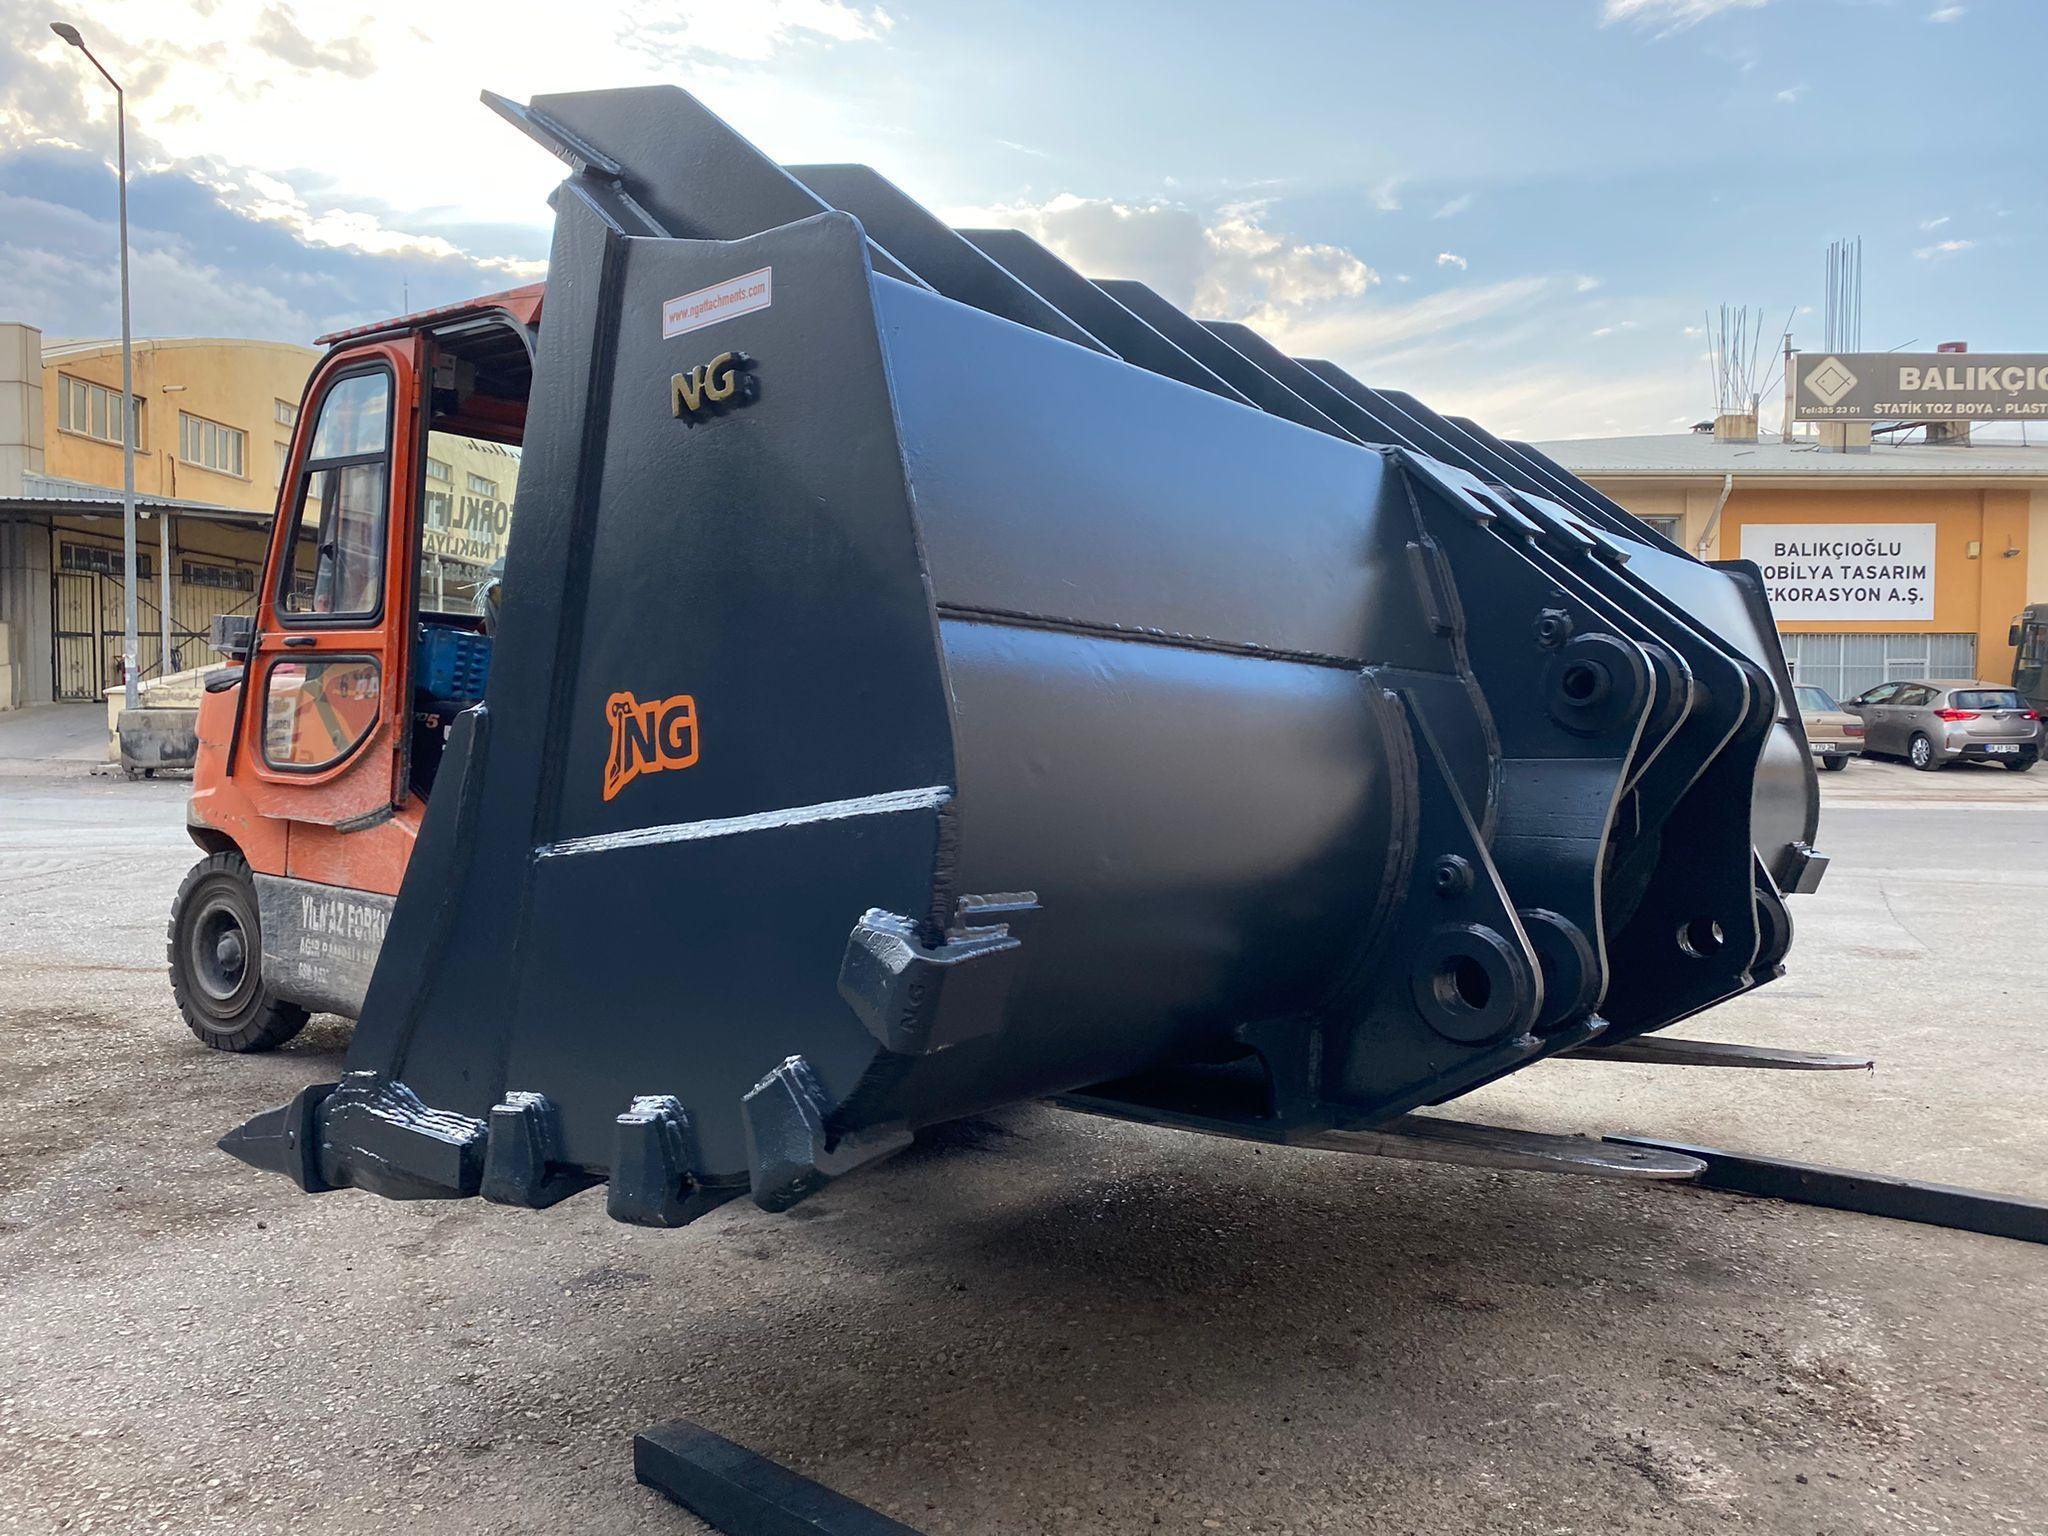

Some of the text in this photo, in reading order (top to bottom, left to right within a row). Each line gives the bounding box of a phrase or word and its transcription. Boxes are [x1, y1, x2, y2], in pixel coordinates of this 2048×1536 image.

[667, 283, 766, 323] www.ngattachments.com
[671, 351, 737, 418] NG
[1836, 406, 1848, 414] 23
[1850, 406, 1860, 414] 01
[1873, 401, 1921, 414] STATİK
[1925, 404, 1952, 414] TOZ
[1956, 404, 1993, 414] BOYA
[1774, 538, 1902, 560] BALIKÇIOĞLU
[1759, 562, 1926, 580] OBİLYA TASARIM
[1888, 588, 1924, 605] A.Ş.
[347, 903, 393, 943] FORKL
